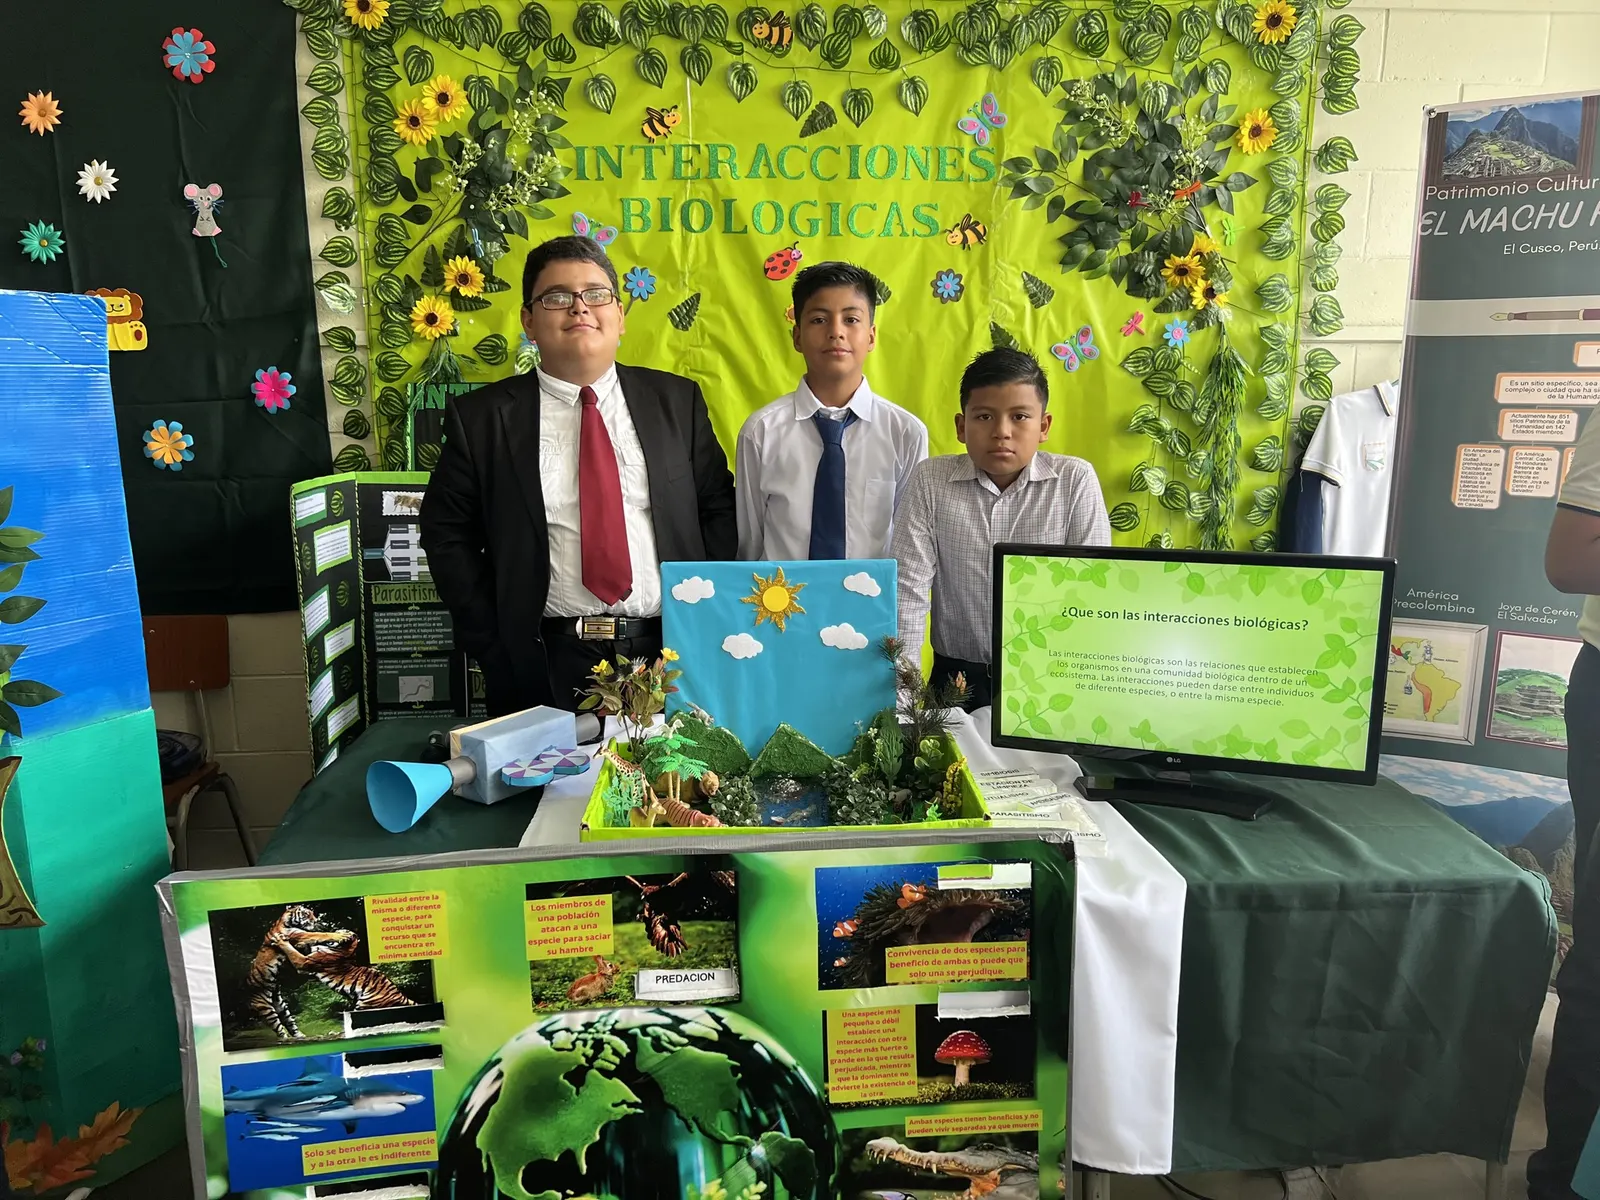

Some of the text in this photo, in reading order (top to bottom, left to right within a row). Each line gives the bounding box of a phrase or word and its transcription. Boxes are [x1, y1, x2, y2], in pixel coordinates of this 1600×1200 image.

[573, 143, 997, 183] INTERACCIONES
[1426, 181, 1529, 201] Patrimonio
[619, 197, 941, 238] BIOLOGICAS
[1420, 210, 1448, 236] EL
[1459, 201, 1584, 234] MACHU
[1503, 244, 1515, 255] El
[1519, 243, 1564, 254] Cusco,
[1407, 588, 1458, 600] América
[1498, 602, 1579, 618] Joya de Cerén,
[1062, 606, 1308, 631] ¿Que son las interacciones biológicas?
[1498, 611, 1558, 624] El Salvador
[1064, 651, 1119, 662] interacciones
[1122, 655, 1164, 665] biológicas
[1185, 659, 1197, 667] las
[1200, 661, 1245, 671] relaciones
[1248, 665, 1265, 673] que
[1268, 667, 1318, 676] establecen
[1071, 663, 1119, 672] organismos
[1153, 669, 1202, 678] comunidad
[1205, 672, 1245, 682] biológica
[1248, 675, 1278, 684] dentro
[1281, 677, 1293, 685] de
[1050, 671, 1098, 681] ecosistema.
[1101, 674, 1115, 682] Las
[1117, 676, 1174, 686] interacciones
[1177, 681, 1210, 690] pueden
[1213, 683, 1237, 691] darse
[1267, 688, 1314, 698] individuos
[1088, 684, 1126, 693] diferente
[1129, 687, 1168, 697] especies,
[1179, 692, 1202, 700] entre
[1215, 694, 1244, 703] misma
[1247, 697, 1284, 706] especie.
[984, 792, 1028, 800] UTUALISMO
[372, 897, 408, 905] Rivalidad
[548, 901, 592, 910] miembros
[382, 915, 412, 923] especie,
[557, 911, 600, 922] población
[382, 924, 422, 932] conquistar
[541, 925, 571, 933] atacan
[528, 933, 611, 946] especie para saciar
[409, 949, 442, 957] cantidad
[560, 946, 593, 954] hambre
[888, 946, 1025, 958] Convivencia de dos especies para
[890, 957, 1024, 969] beneficio de ambas puede que
[655, 972, 715, 984] PREDACION
[909, 970, 926, 978] solo
[958, 968, 1005, 977] perjudique.
[858, 1009, 884, 1018] especie
[830, 1056, 855, 1065] grande
[834, 1065, 877, 1073] perjudicada,
[934, 1116, 963, 1124] especies
[988, 1113, 1023, 1121] beneficios
[908, 1127, 934, 1135] pueden
[952, 1124, 986, 1133] separadas
[304, 1150, 324, 1158] Solo
[339, 1142, 380, 1154] beneficia
[402, 1138, 435, 1148] especie
[381, 1149, 432, 1160] indiferente
